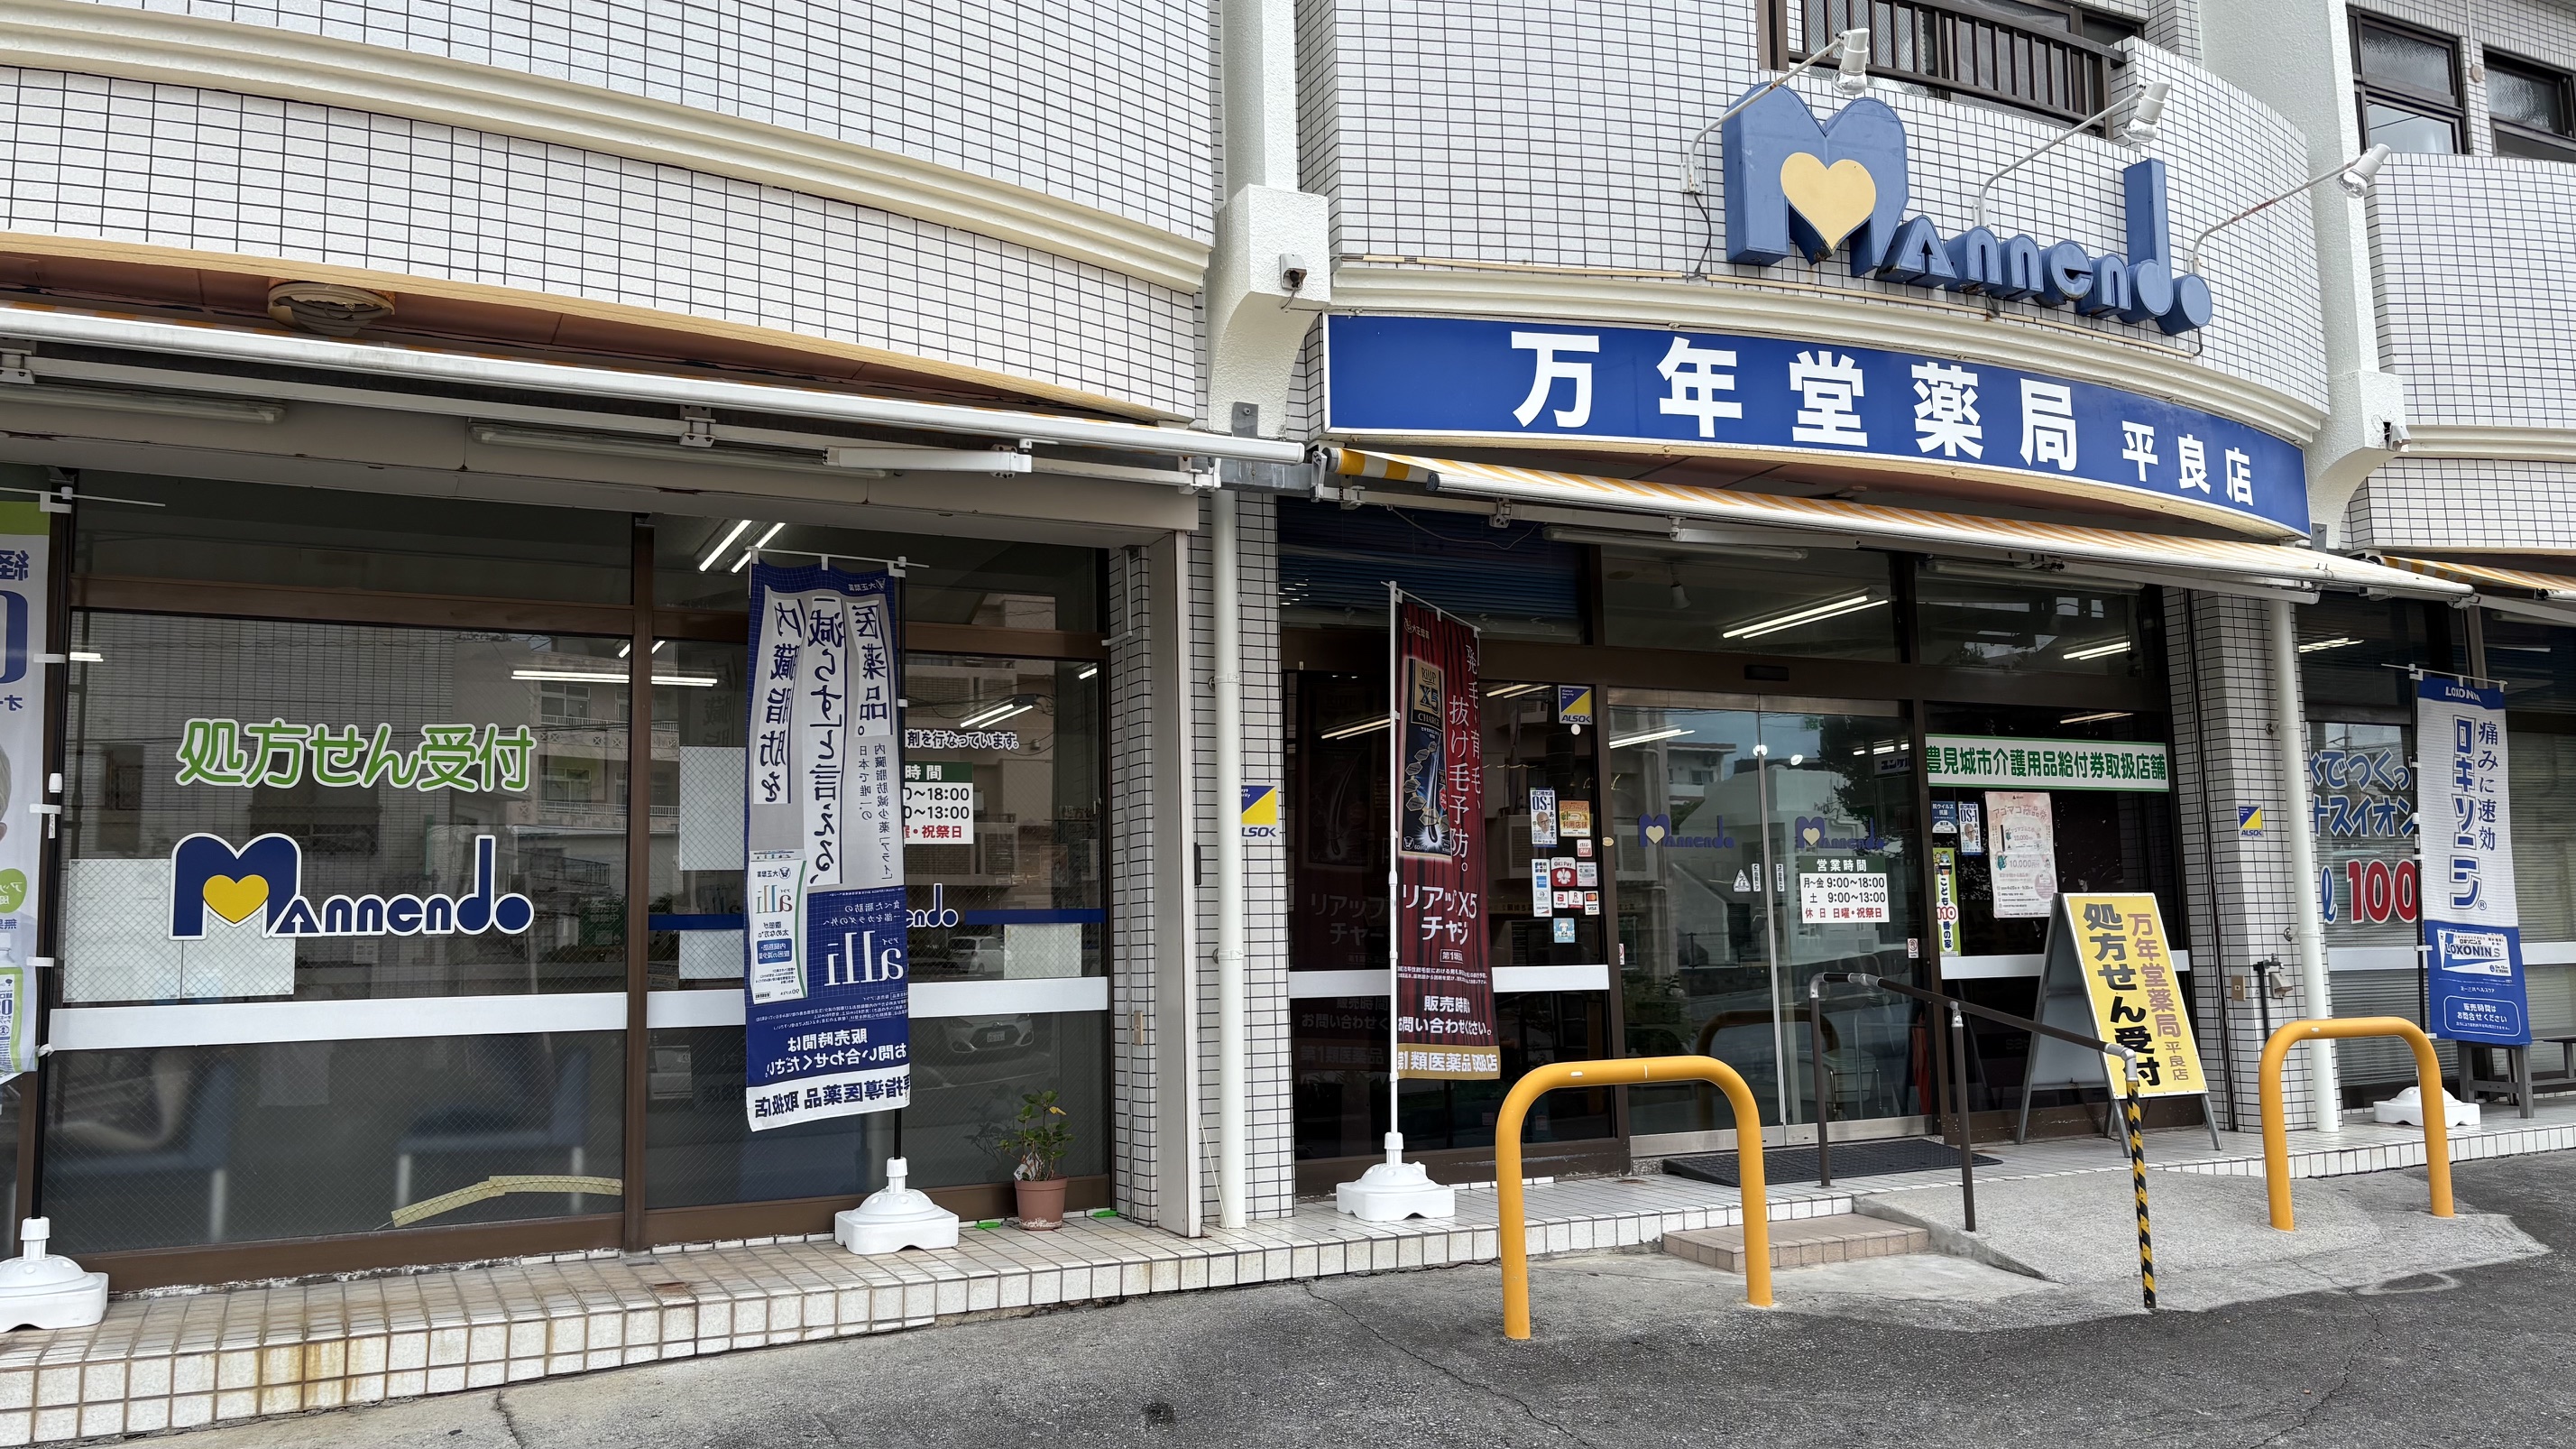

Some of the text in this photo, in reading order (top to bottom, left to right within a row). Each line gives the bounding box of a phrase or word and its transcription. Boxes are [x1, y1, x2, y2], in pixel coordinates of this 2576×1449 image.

[1510, 329, 2255, 506] 万年堂薬局 平良店
[1561, 715, 1591, 723] ALSOK
[905, 729, 1020, 751] 剤を行なっています。
[176, 717, 537, 792] 処方せん受付
[1926, 745, 2166, 780] 豊見城市介護用品給付券取扱店舗
[1449, 694, 1471, 872] 抜け毛予防。
[2477, 720, 2498, 852] 痛みに速効
[1532, 796, 1554, 811] OS-1
[1960, 808, 1978, 823] OS-1
[1241, 826, 1276, 837] LSOK
[1817, 859, 1868, 872] 営業時間
[1809, 893, 1818, 903] 土
[2346, 859, 2417, 924] 100
[1833, 907, 1882, 918] 日曜・祝祭日
[2127, 913, 2189, 1081] 万年堂薬局 平良店
